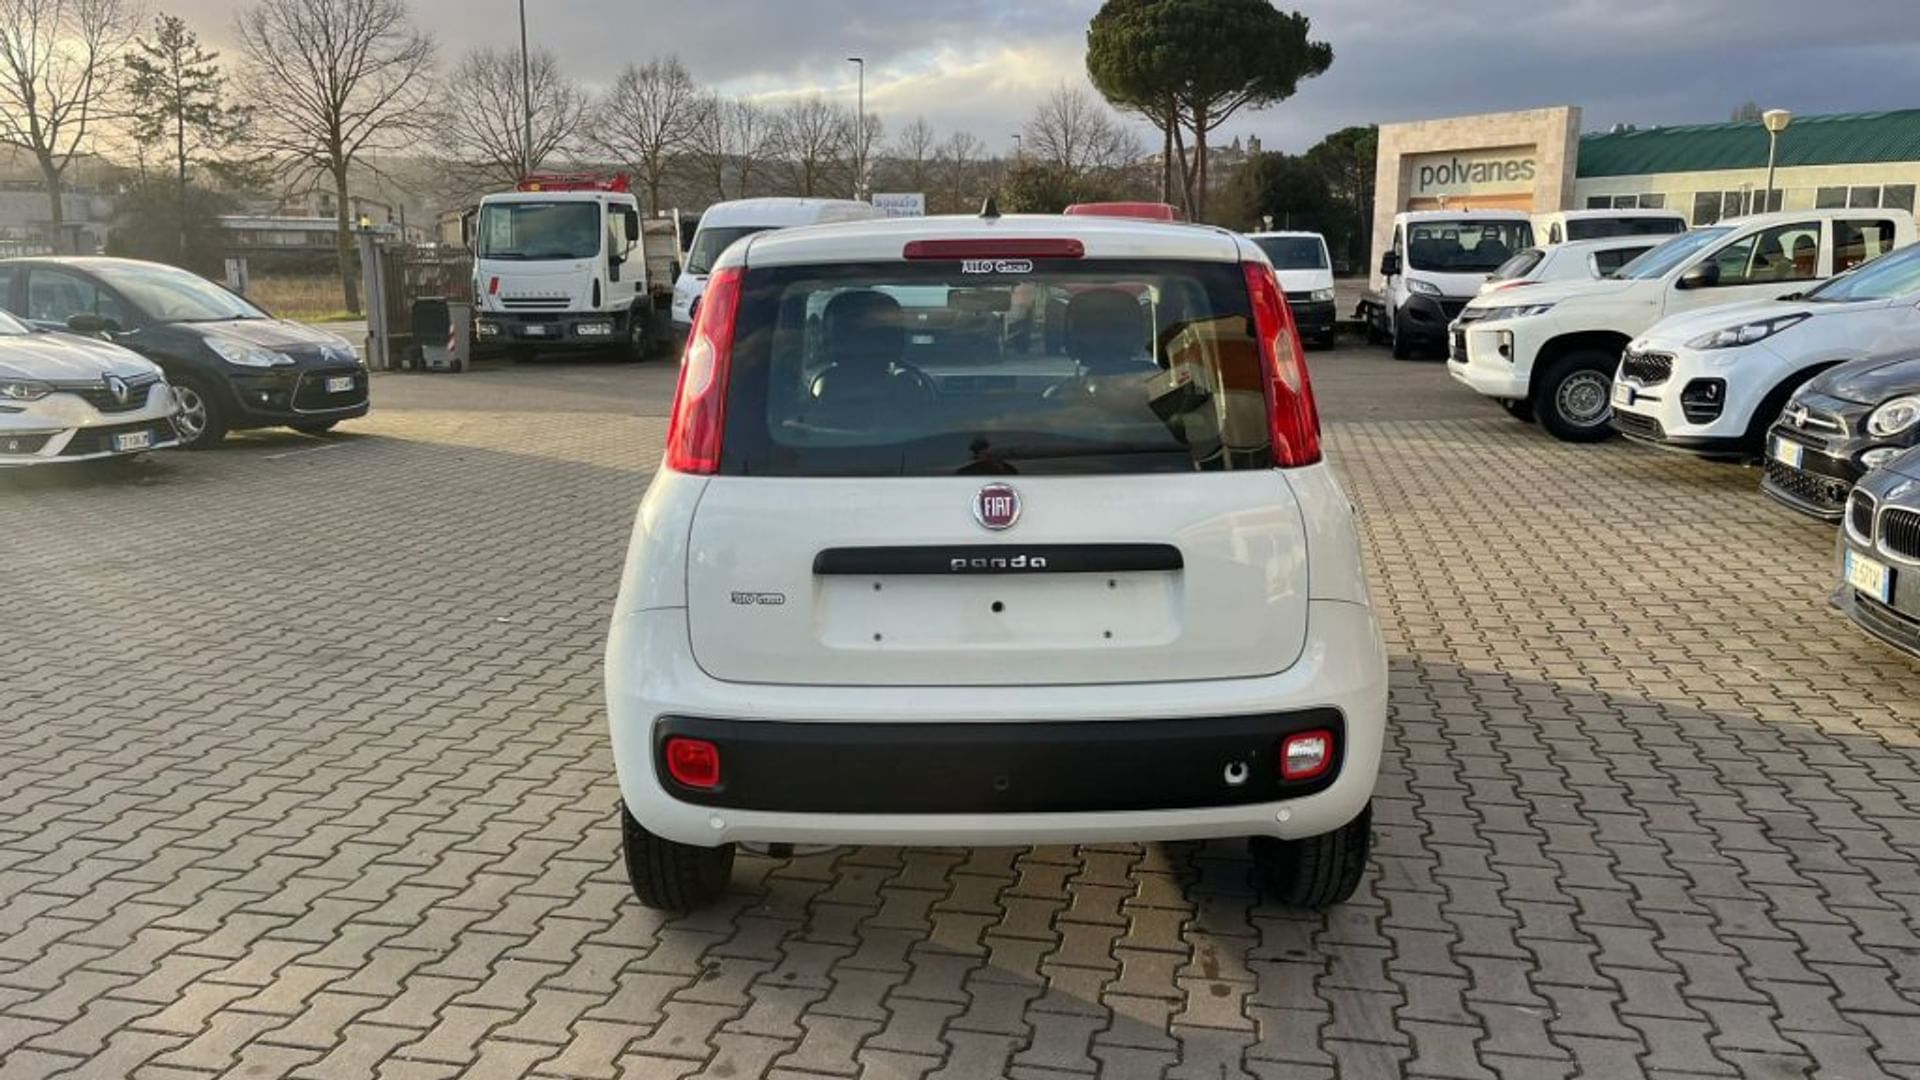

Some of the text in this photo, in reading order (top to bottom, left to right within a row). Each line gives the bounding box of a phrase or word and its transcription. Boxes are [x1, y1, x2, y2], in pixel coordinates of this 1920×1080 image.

[1420, 156, 1536, 193] polvanes
[984, 496, 1012, 518] FIAT
[950, 554, 1046, 571] panda
